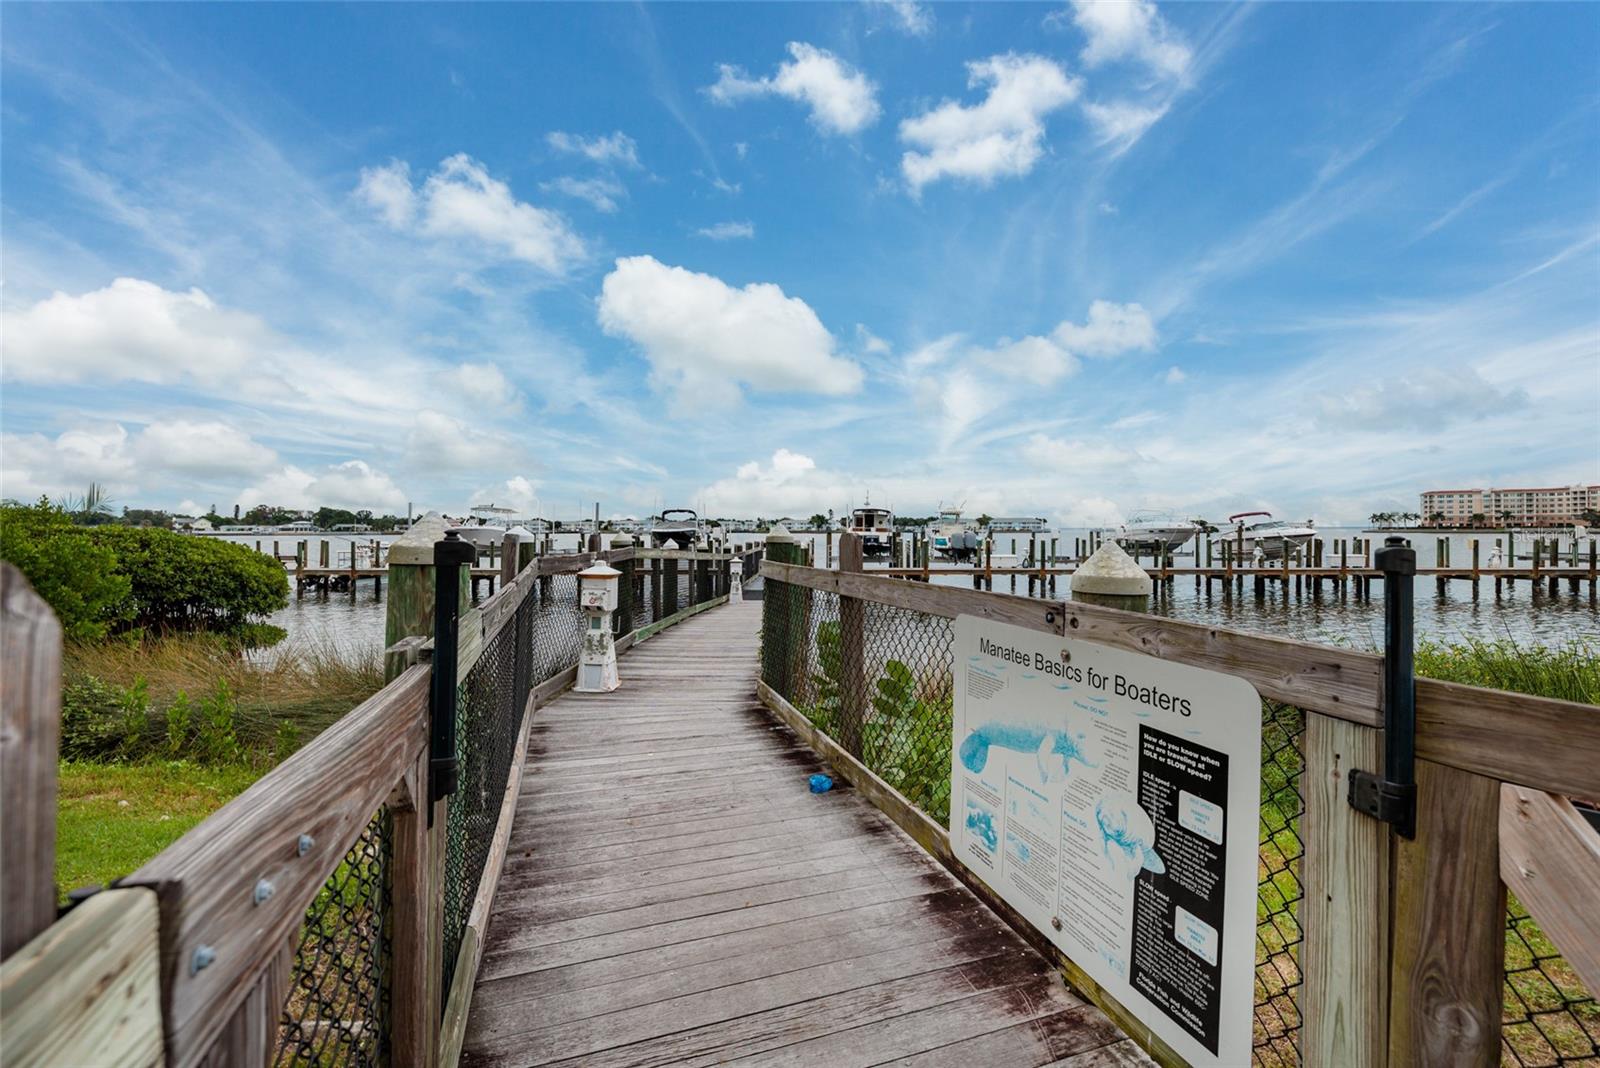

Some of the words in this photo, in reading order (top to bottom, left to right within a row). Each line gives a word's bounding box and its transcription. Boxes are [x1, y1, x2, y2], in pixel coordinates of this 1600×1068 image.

[980, 637, 1031, 667] Manatee
[1035, 652, 1082, 683] Basics
[1087, 667, 1109, 690] for
[1114, 674, 1192, 717] Boaters
[1143, 732, 1157, 743] How
[1158, 738, 1166, 746] do
[1167, 742, 1179, 751] you
[1180, 746, 1198, 758] know
[1200, 753, 1219, 766] when
[1143, 741, 1154, 750] you
[1155, 746, 1165, 754] are
[1167, 749, 1196, 767] traveling
[1197, 761, 1204, 770] at
[1143, 748, 1157, 759] IDLE
[1166, 757, 1186, 771] SLOW
[1187, 766, 1211, 781] speed?
[1142, 770, 1153, 780] IDLE
[1154, 775, 1169, 787] speed
[1169, 995, 1180, 1009] and
